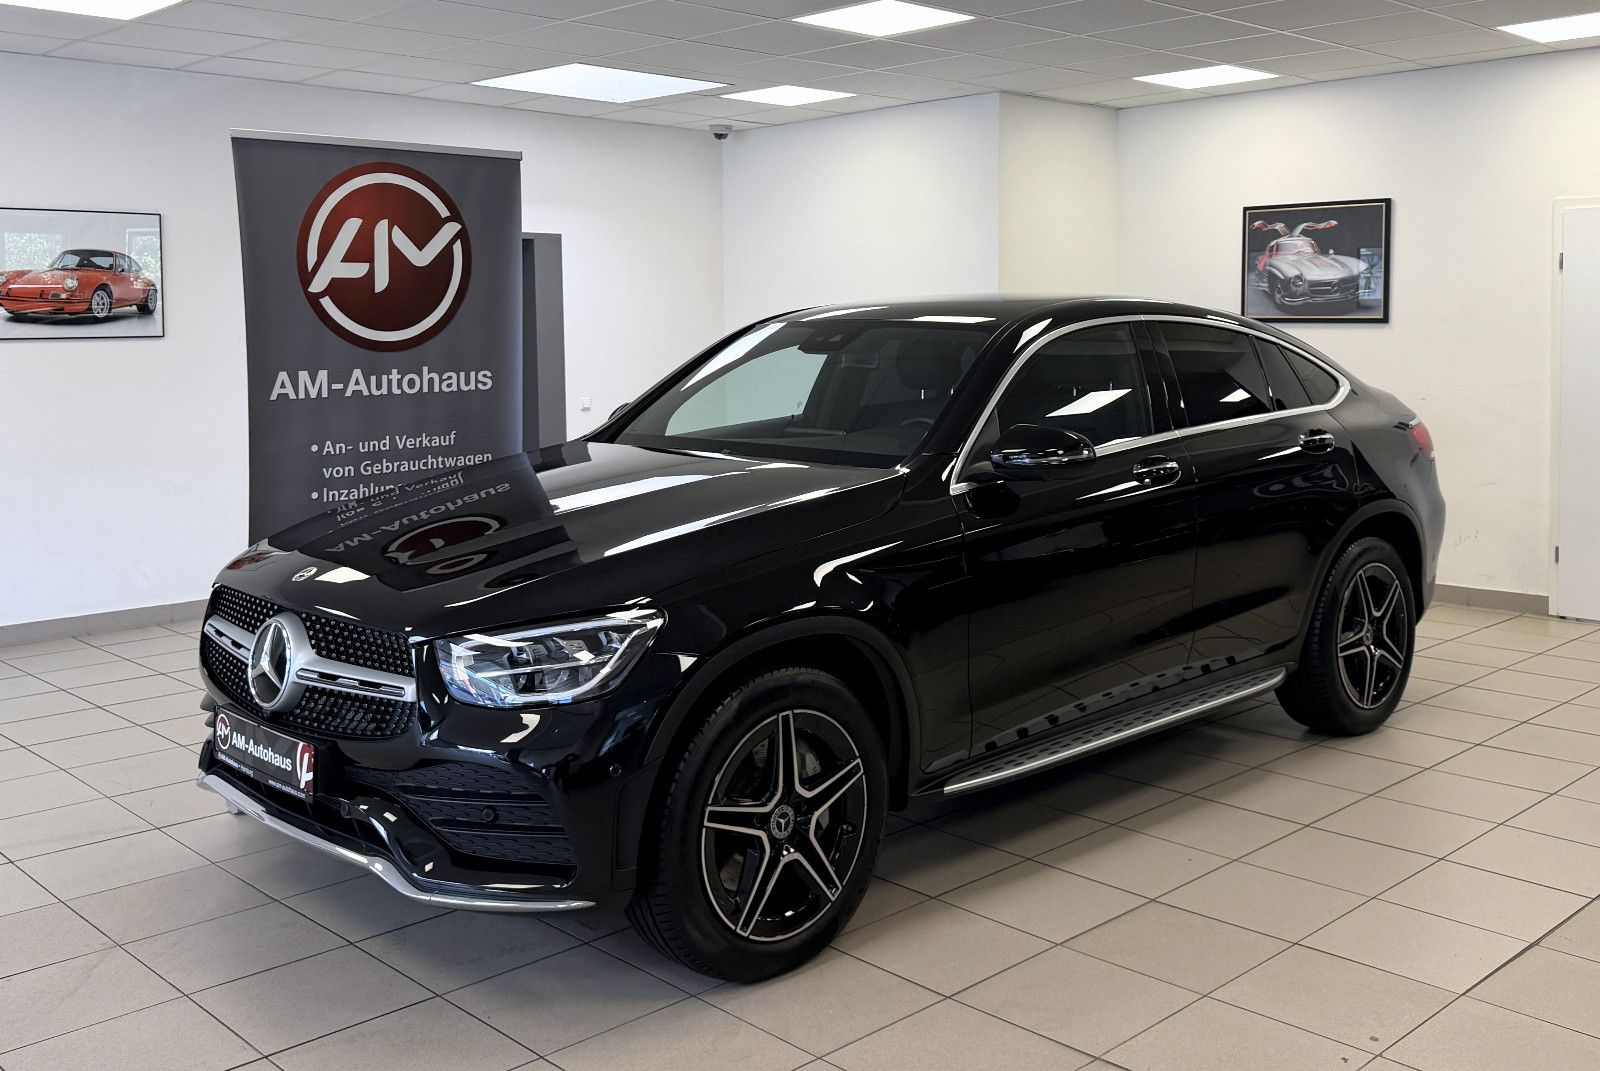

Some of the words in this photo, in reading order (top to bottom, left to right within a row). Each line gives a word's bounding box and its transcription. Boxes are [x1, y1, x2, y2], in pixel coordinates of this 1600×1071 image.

[269, 366, 494, 401] AM-Autohaus
[322, 440, 354, 456] An-
[359, 435, 390, 453] und
[395, 430, 457, 450] Verkauf
[322, 464, 355, 479] von
[360, 453, 493, 476] Gebrauchtwagen
[231, 731, 293, 771] AM-Autohaus
